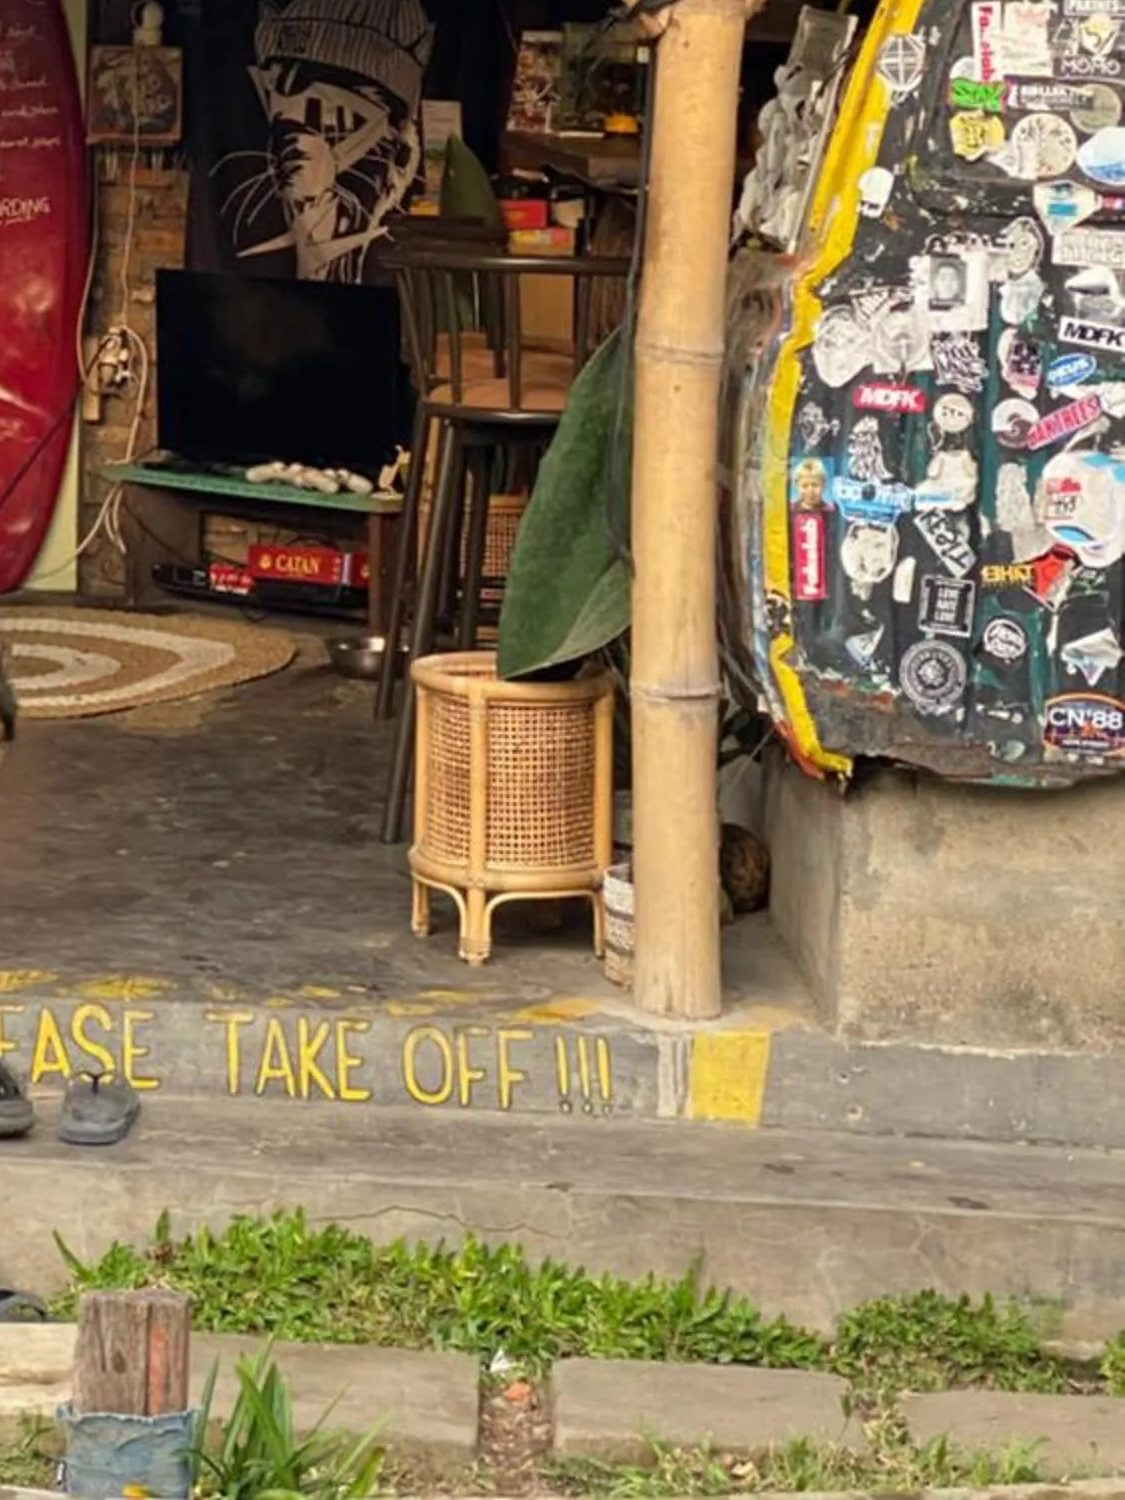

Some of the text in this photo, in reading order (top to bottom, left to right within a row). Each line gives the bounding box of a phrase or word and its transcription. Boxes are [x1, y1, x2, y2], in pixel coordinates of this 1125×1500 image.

[275, 553, 321, 575] CATAN
[203, 1010, 372, 1102] TAKE
[401, 1025, 536, 1109] OFF
[556, 1035, 613, 1116] !!!
